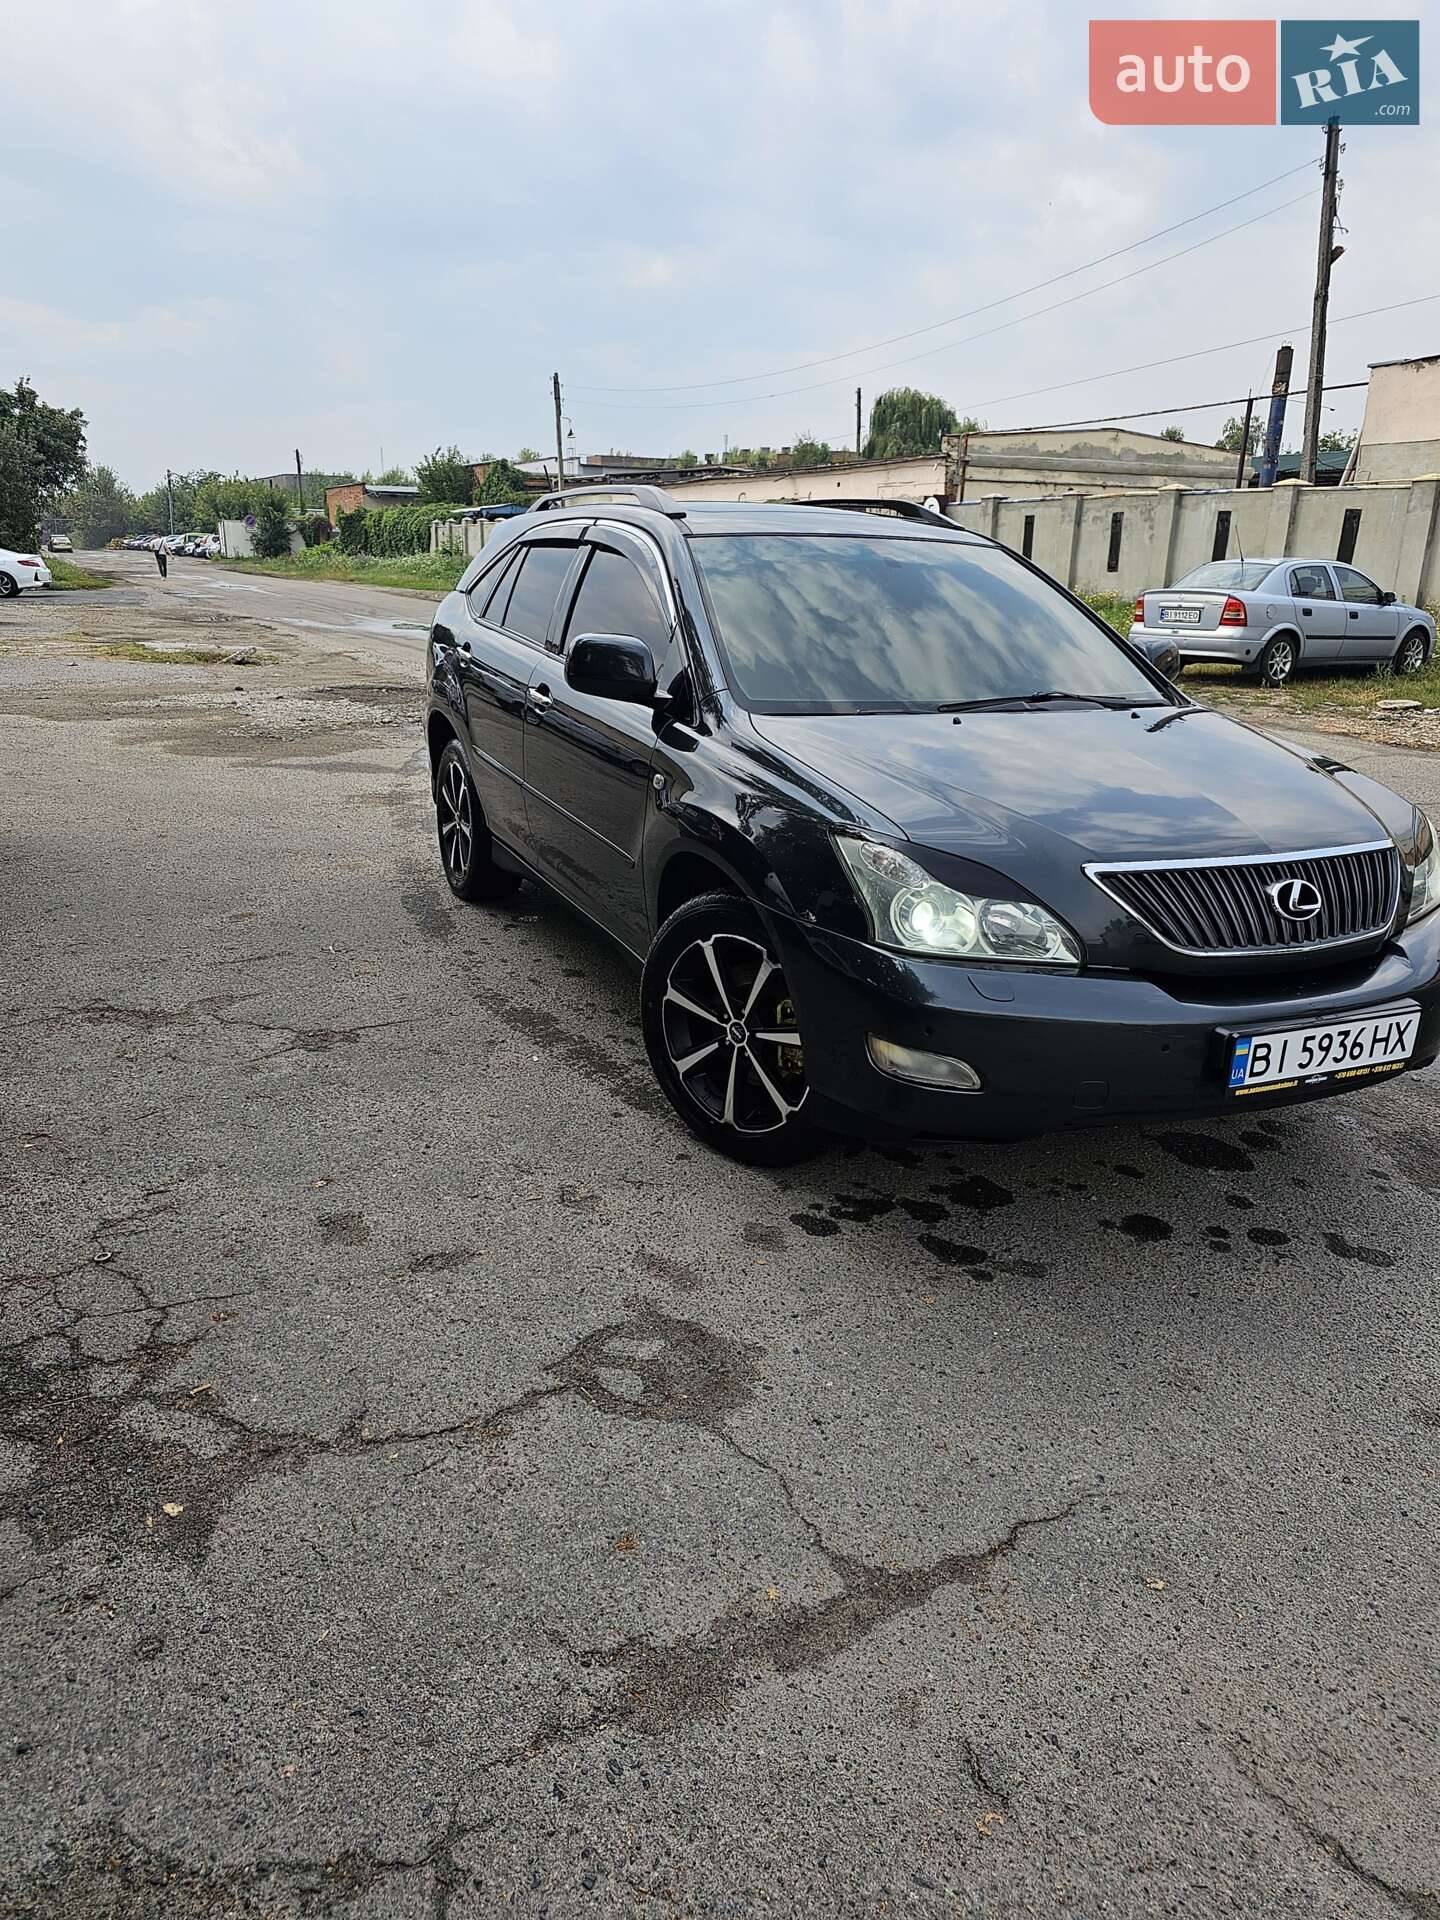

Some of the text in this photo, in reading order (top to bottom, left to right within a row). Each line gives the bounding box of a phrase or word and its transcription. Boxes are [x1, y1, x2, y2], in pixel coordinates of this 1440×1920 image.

[1249, 1019, 1413, 1078] BI 5936 HX
[1231, 1069, 1245, 1080] UA
